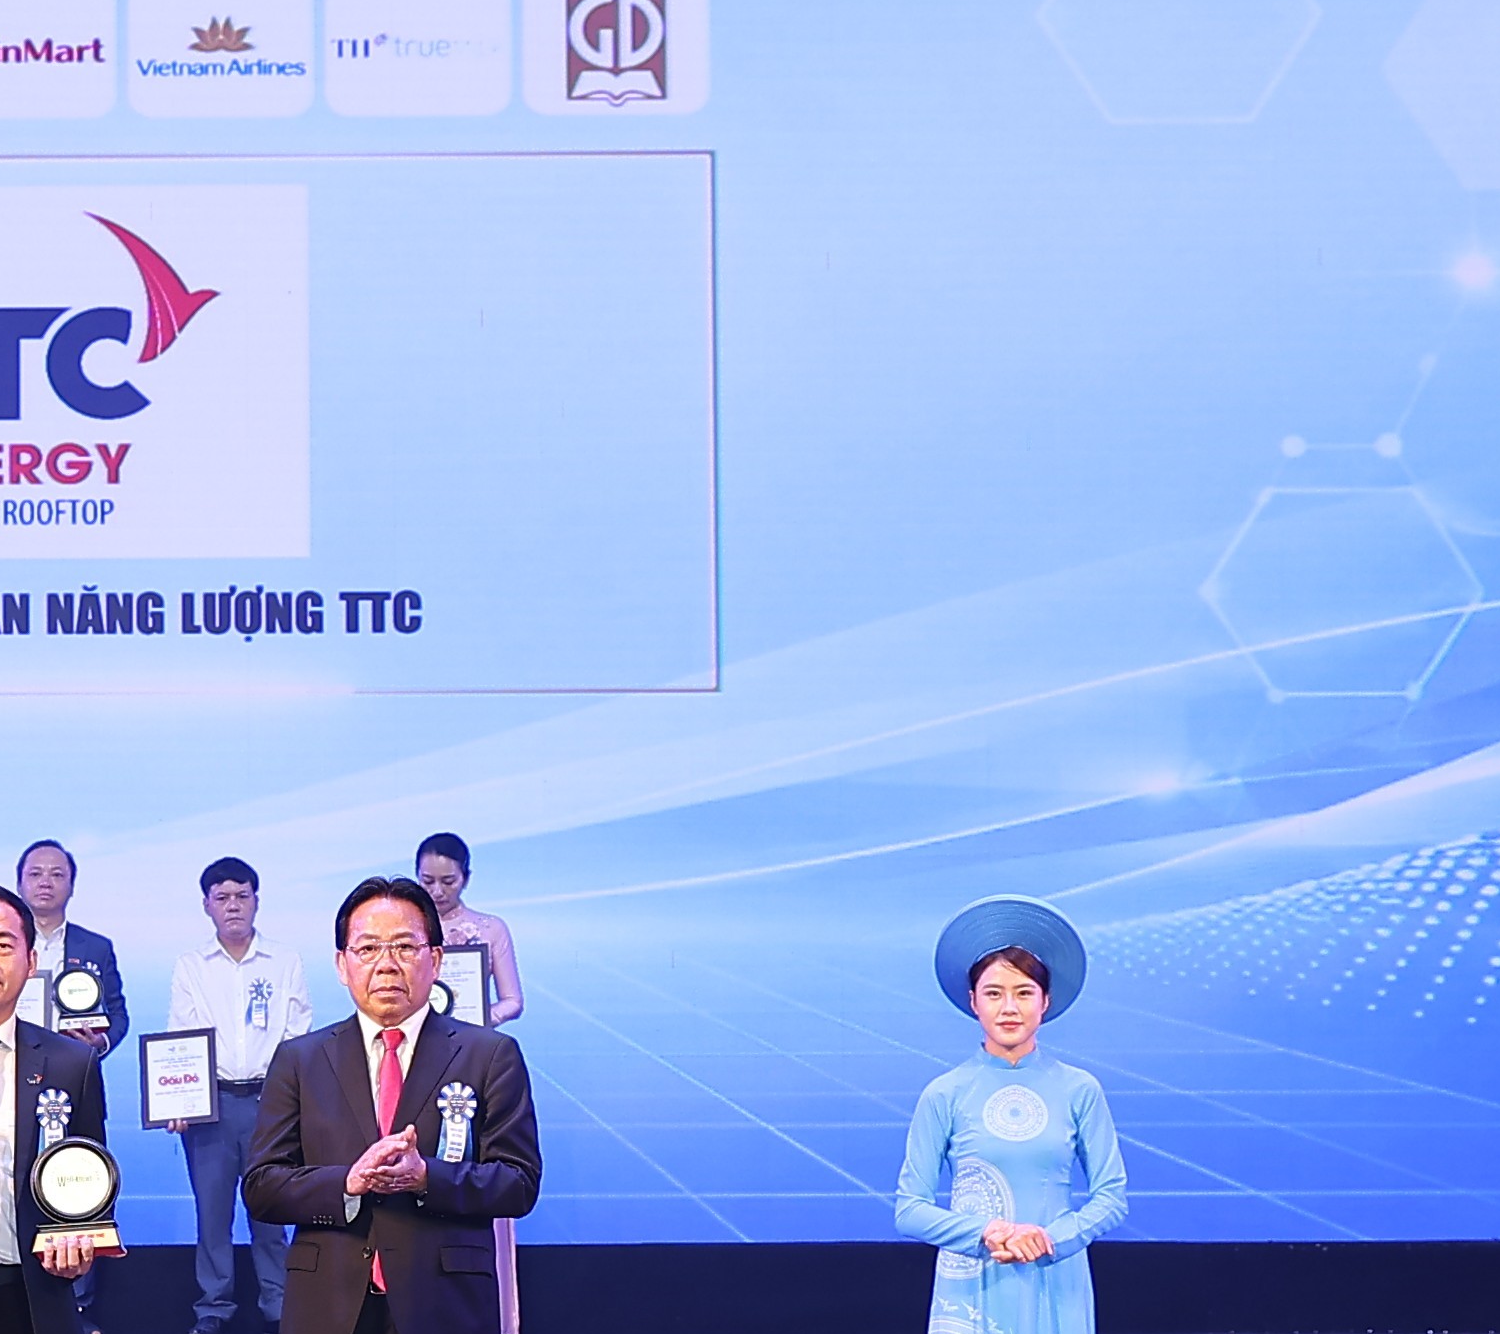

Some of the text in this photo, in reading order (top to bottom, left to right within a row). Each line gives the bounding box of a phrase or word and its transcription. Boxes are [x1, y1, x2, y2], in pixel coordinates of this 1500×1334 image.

[136, 58, 306, 76] Vietnam Airlines
[3, 499, 114, 524] ROOFTOP
[47, 584, 165, 635] NĂNG
[181, 584, 324, 642] LƯỢNG
[340, 590, 422, 634] TTC
